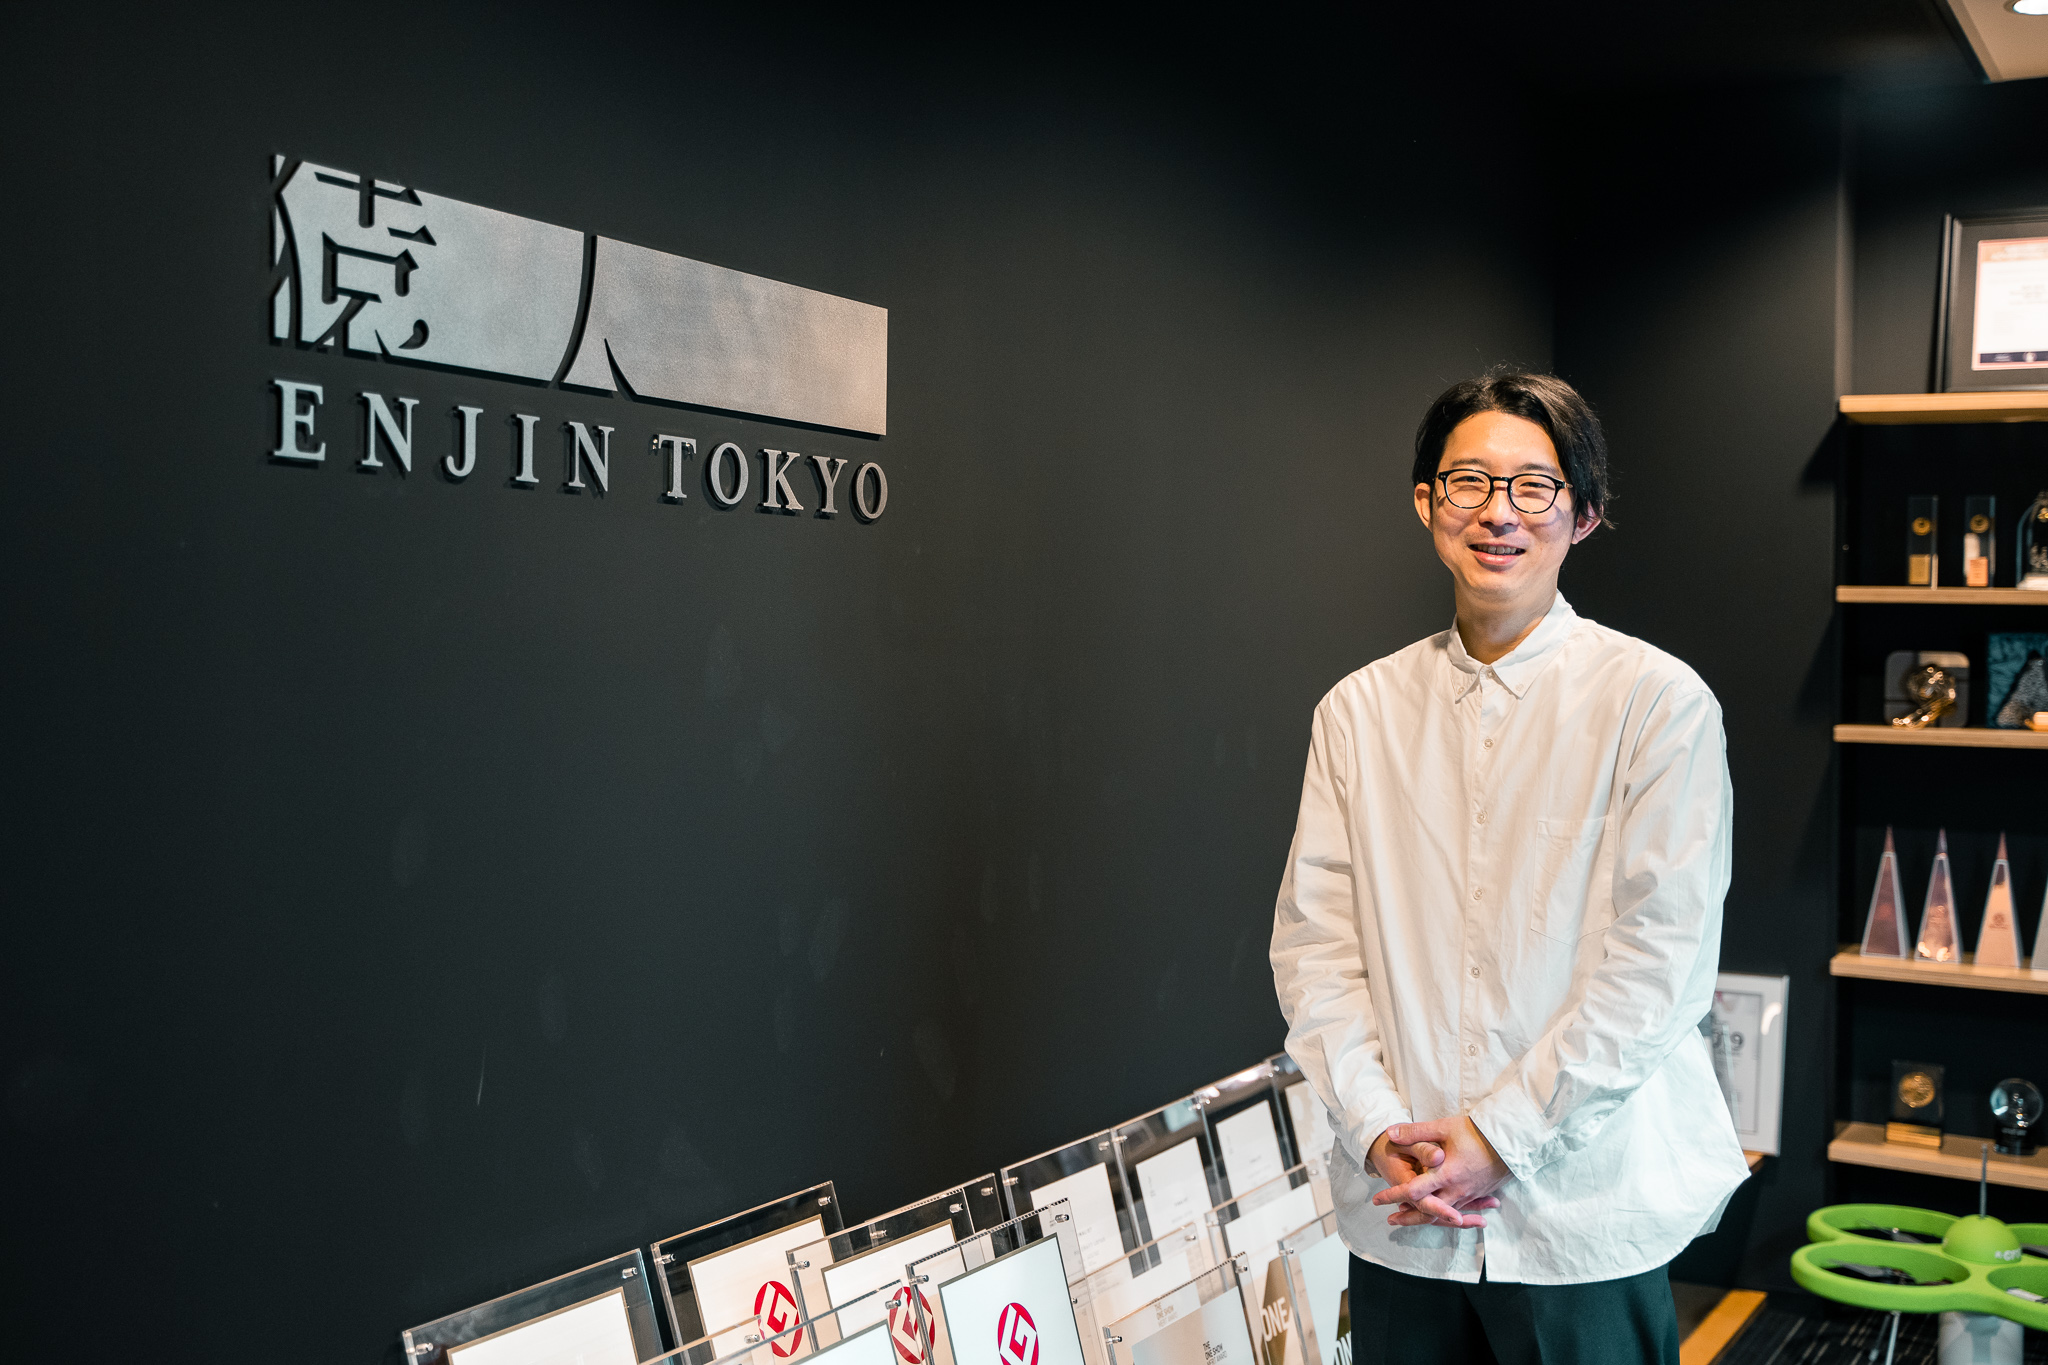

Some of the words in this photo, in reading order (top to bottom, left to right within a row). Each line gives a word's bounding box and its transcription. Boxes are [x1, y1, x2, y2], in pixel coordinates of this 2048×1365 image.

[272, 378, 615, 493] ENJIN
[653, 433, 888, 521] TOKYO
[1260, 1296, 1289, 1342] ONE
[1204, 1348, 1213, 1361] ONE
[1212, 1343, 1223, 1357] SHOW
